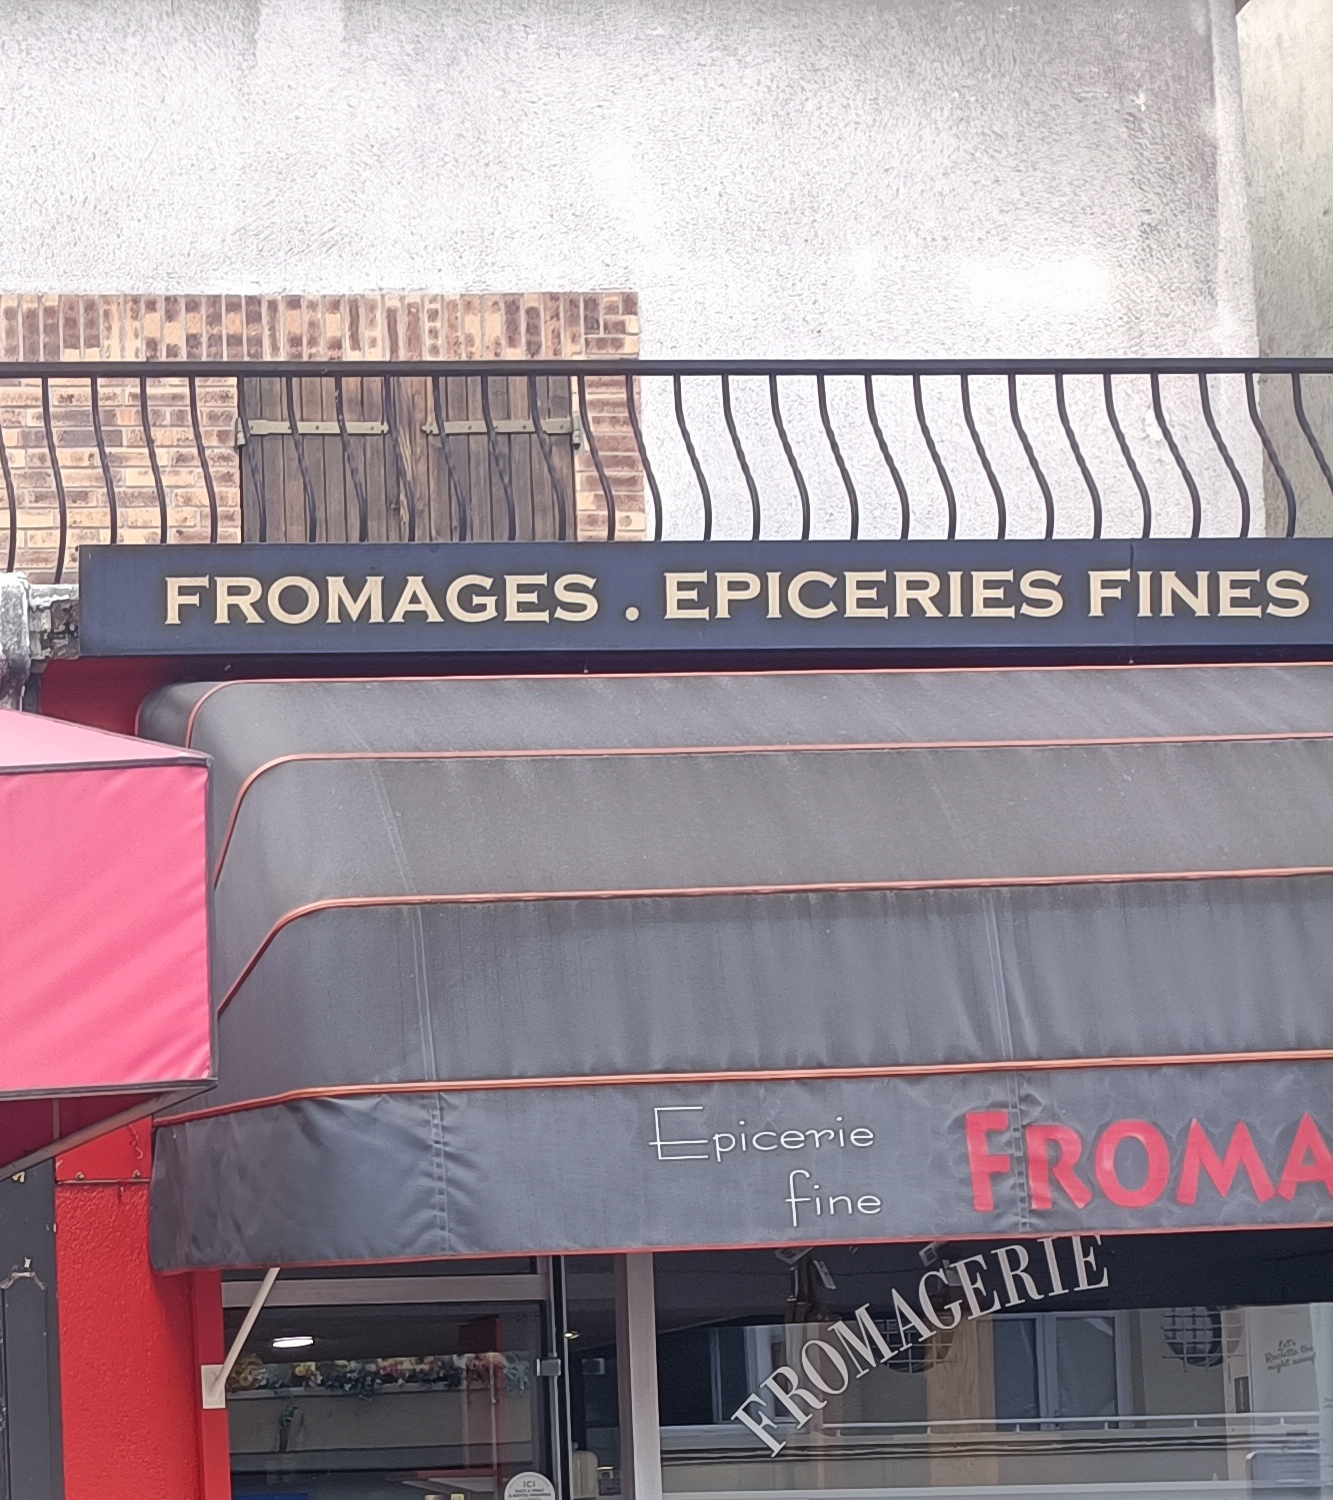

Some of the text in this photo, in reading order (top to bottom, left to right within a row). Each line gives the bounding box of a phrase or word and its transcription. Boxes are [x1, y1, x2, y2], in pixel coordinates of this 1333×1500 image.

[164, 573, 599, 625] FROMAGES
[664, 568, 1065, 621] EPICERIES
[1088, 567, 1311, 618] FINES
[649, 1105, 874, 1163] Epicerie
[785, 1169, 883, 1227] fine
[731, 1234, 1109, 1458] FROMAGERIE
